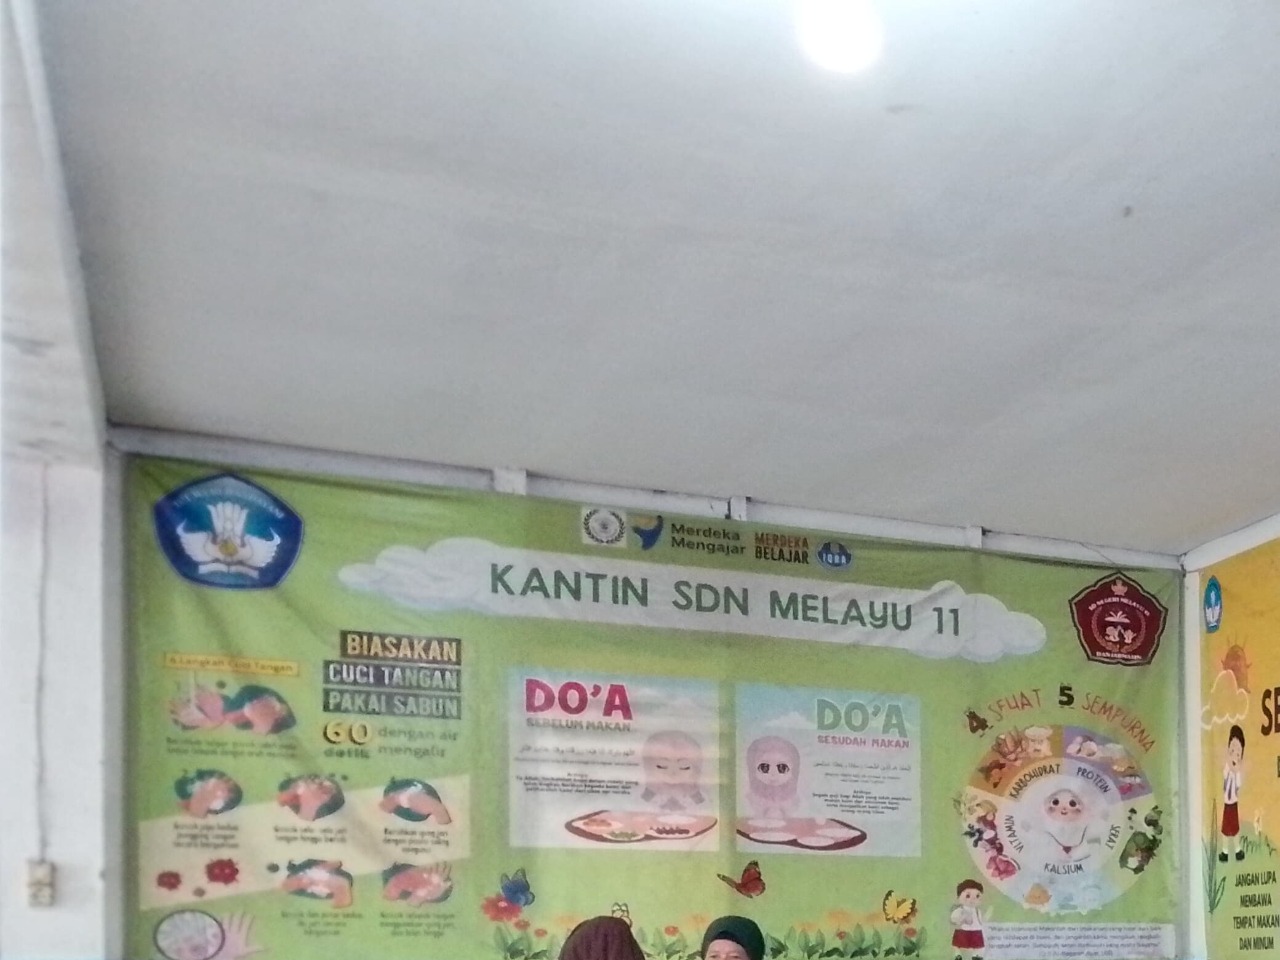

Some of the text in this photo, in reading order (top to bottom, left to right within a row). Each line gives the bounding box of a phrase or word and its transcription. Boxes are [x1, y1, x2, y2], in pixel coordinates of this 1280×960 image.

[671, 523, 741, 541] Merdeka
[754, 532, 809, 550] MERDEKA
[671, 536, 746, 556] Mengajar
[755, 546, 809, 565] BELAJAR
[490, 562, 960, 636] KANTIN SDN MELAYU 11
[347, 634, 457, 662] BIASAKAN
[328, 663, 457, 690] CUCI TANGAN
[328, 691, 458, 717] PAKAI SABUN
[526, 717, 631, 733] SEBELUM MAKAN
[965, 708, 990, 735] 4
[1058, 685, 1076, 707] 5
[1082, 692, 1156, 753] SEMPURNA
[323, 721, 372, 744] 60
[817, 735, 910, 749] SESUDAH MAKAN
[1076, 765, 1112, 794] PROTEIN
[1044, 862, 1085, 875] KALSIUM
[1234, 870, 1277, 888] JANGAN LUPA
[1240, 894, 1272, 909] MEMBAWA
[1233, 914, 1280, 930] TEMPAT MAKAN
[1239, 935, 1274, 951] DAN MINUM
